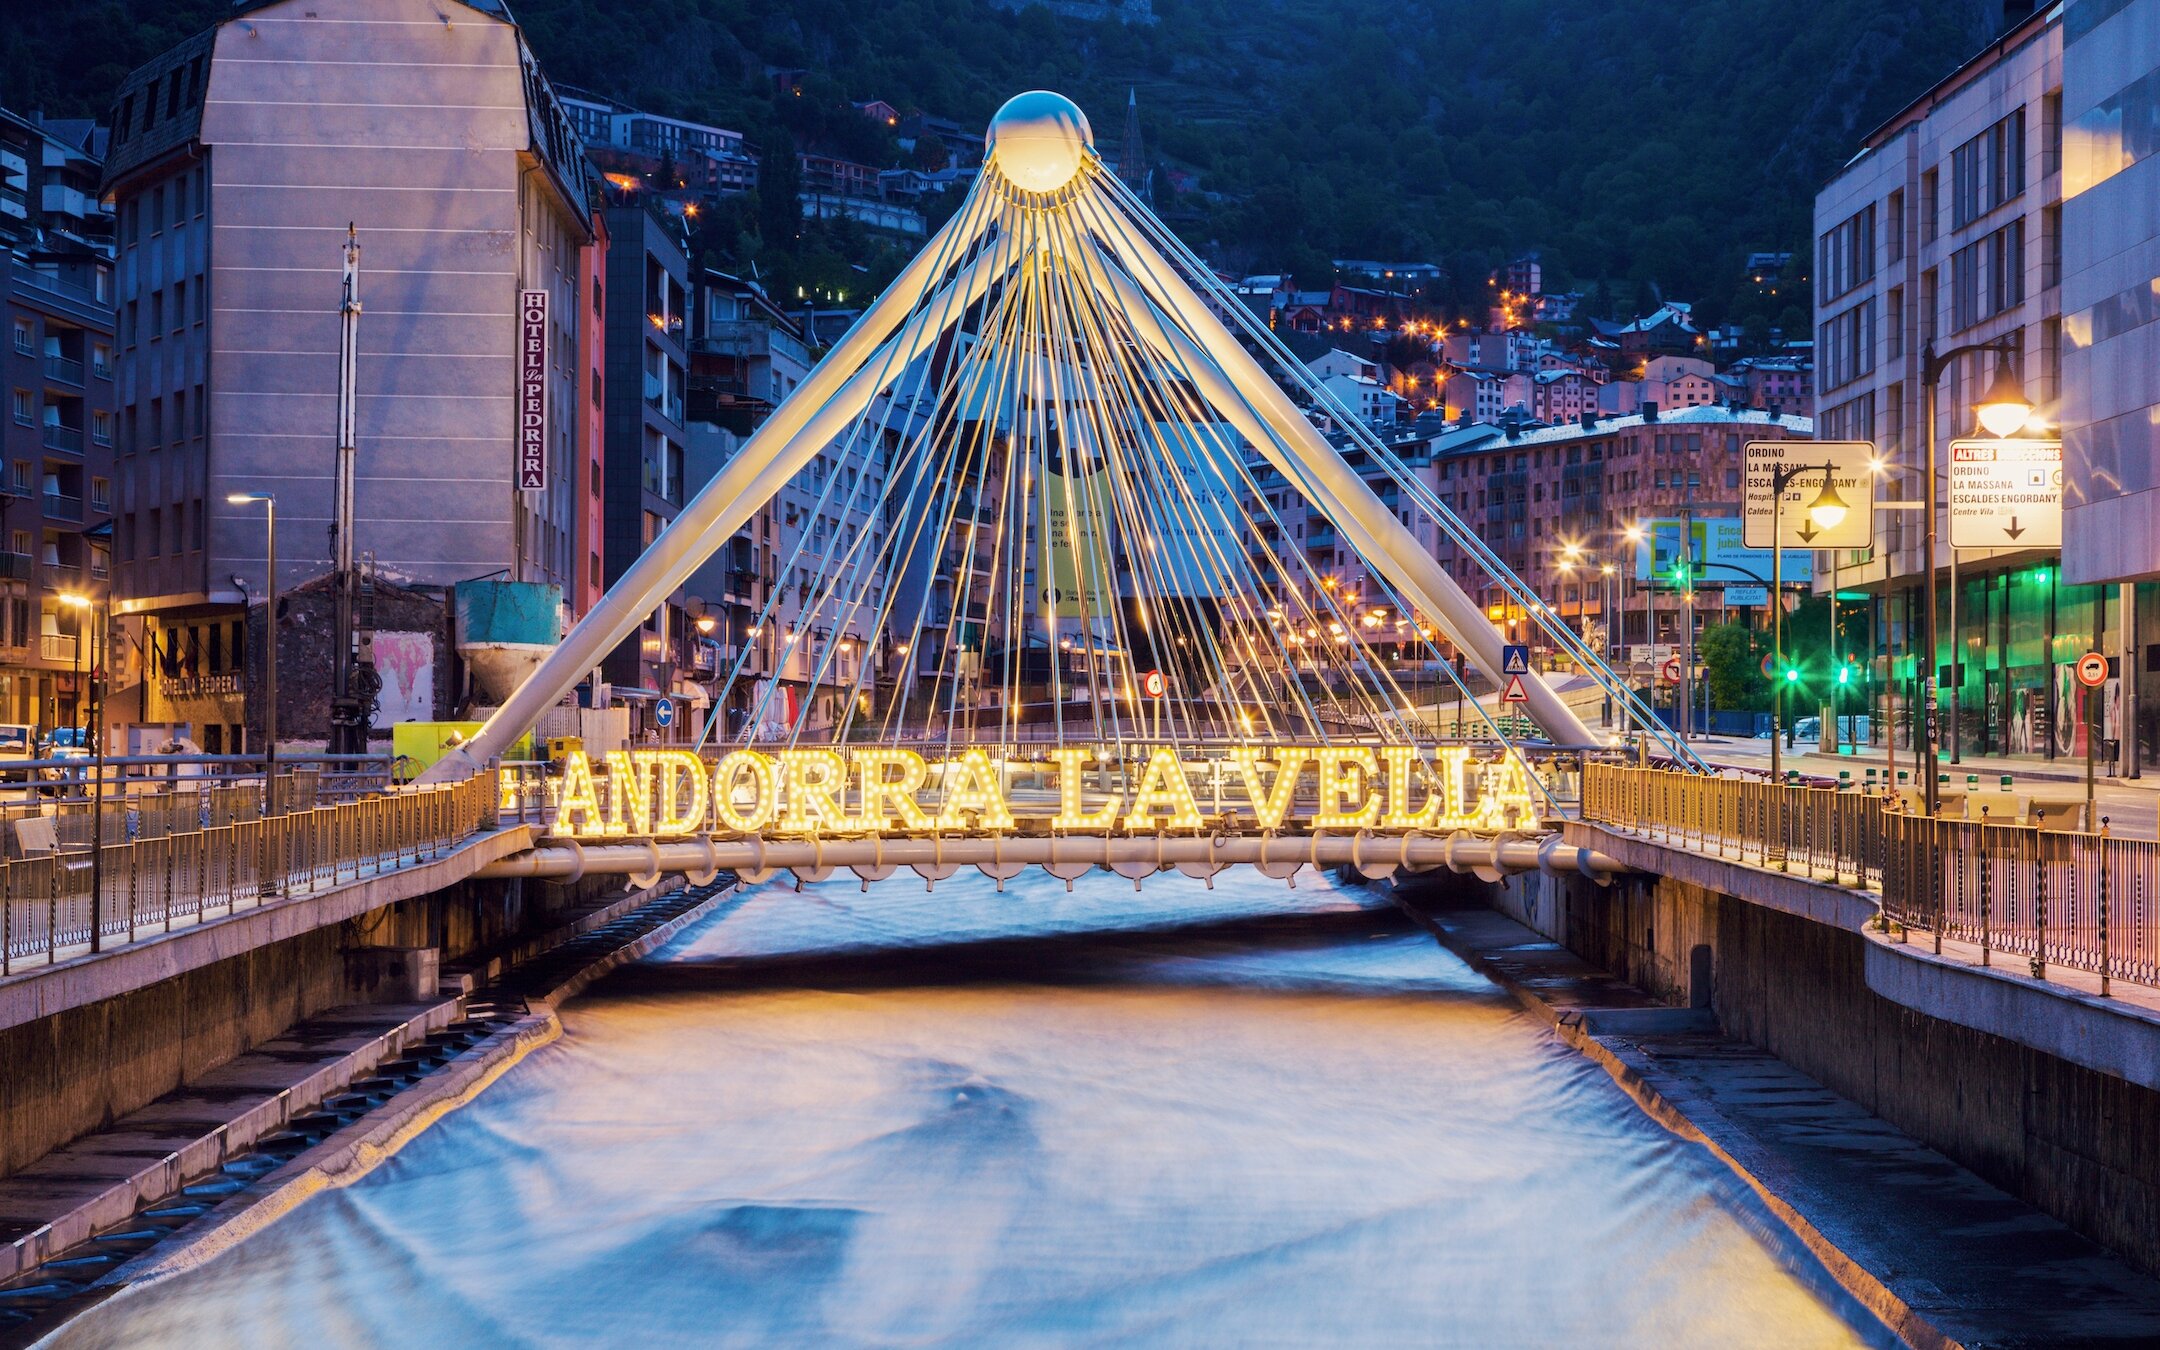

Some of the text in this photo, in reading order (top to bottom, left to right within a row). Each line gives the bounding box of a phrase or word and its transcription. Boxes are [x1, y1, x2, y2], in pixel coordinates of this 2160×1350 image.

[524, 294, 544, 487] HOTEL La PEDRERA
[1748, 448, 1785, 458] ORDINO
[1956, 449, 1994, 460] ALTRES
[1748, 463, 1759, 473] LA
[1953, 466, 1990, 476] ORDINO
[1748, 478, 1857, 488] ESCALES-ENGODANY
[1953, 480, 2014, 489] LA MASSANA
[1748, 492, 1777, 502] Hospit
[1953, 494, 2057, 503] ESCALDES ENGORDANY
[1747, 507, 1773, 515] Caldea
[1953, 508, 1994, 516] Centre Vila
[1718, 525, 1742, 535] Enca
[551, 746, 1541, 836] ANDORRA LA VELLA
